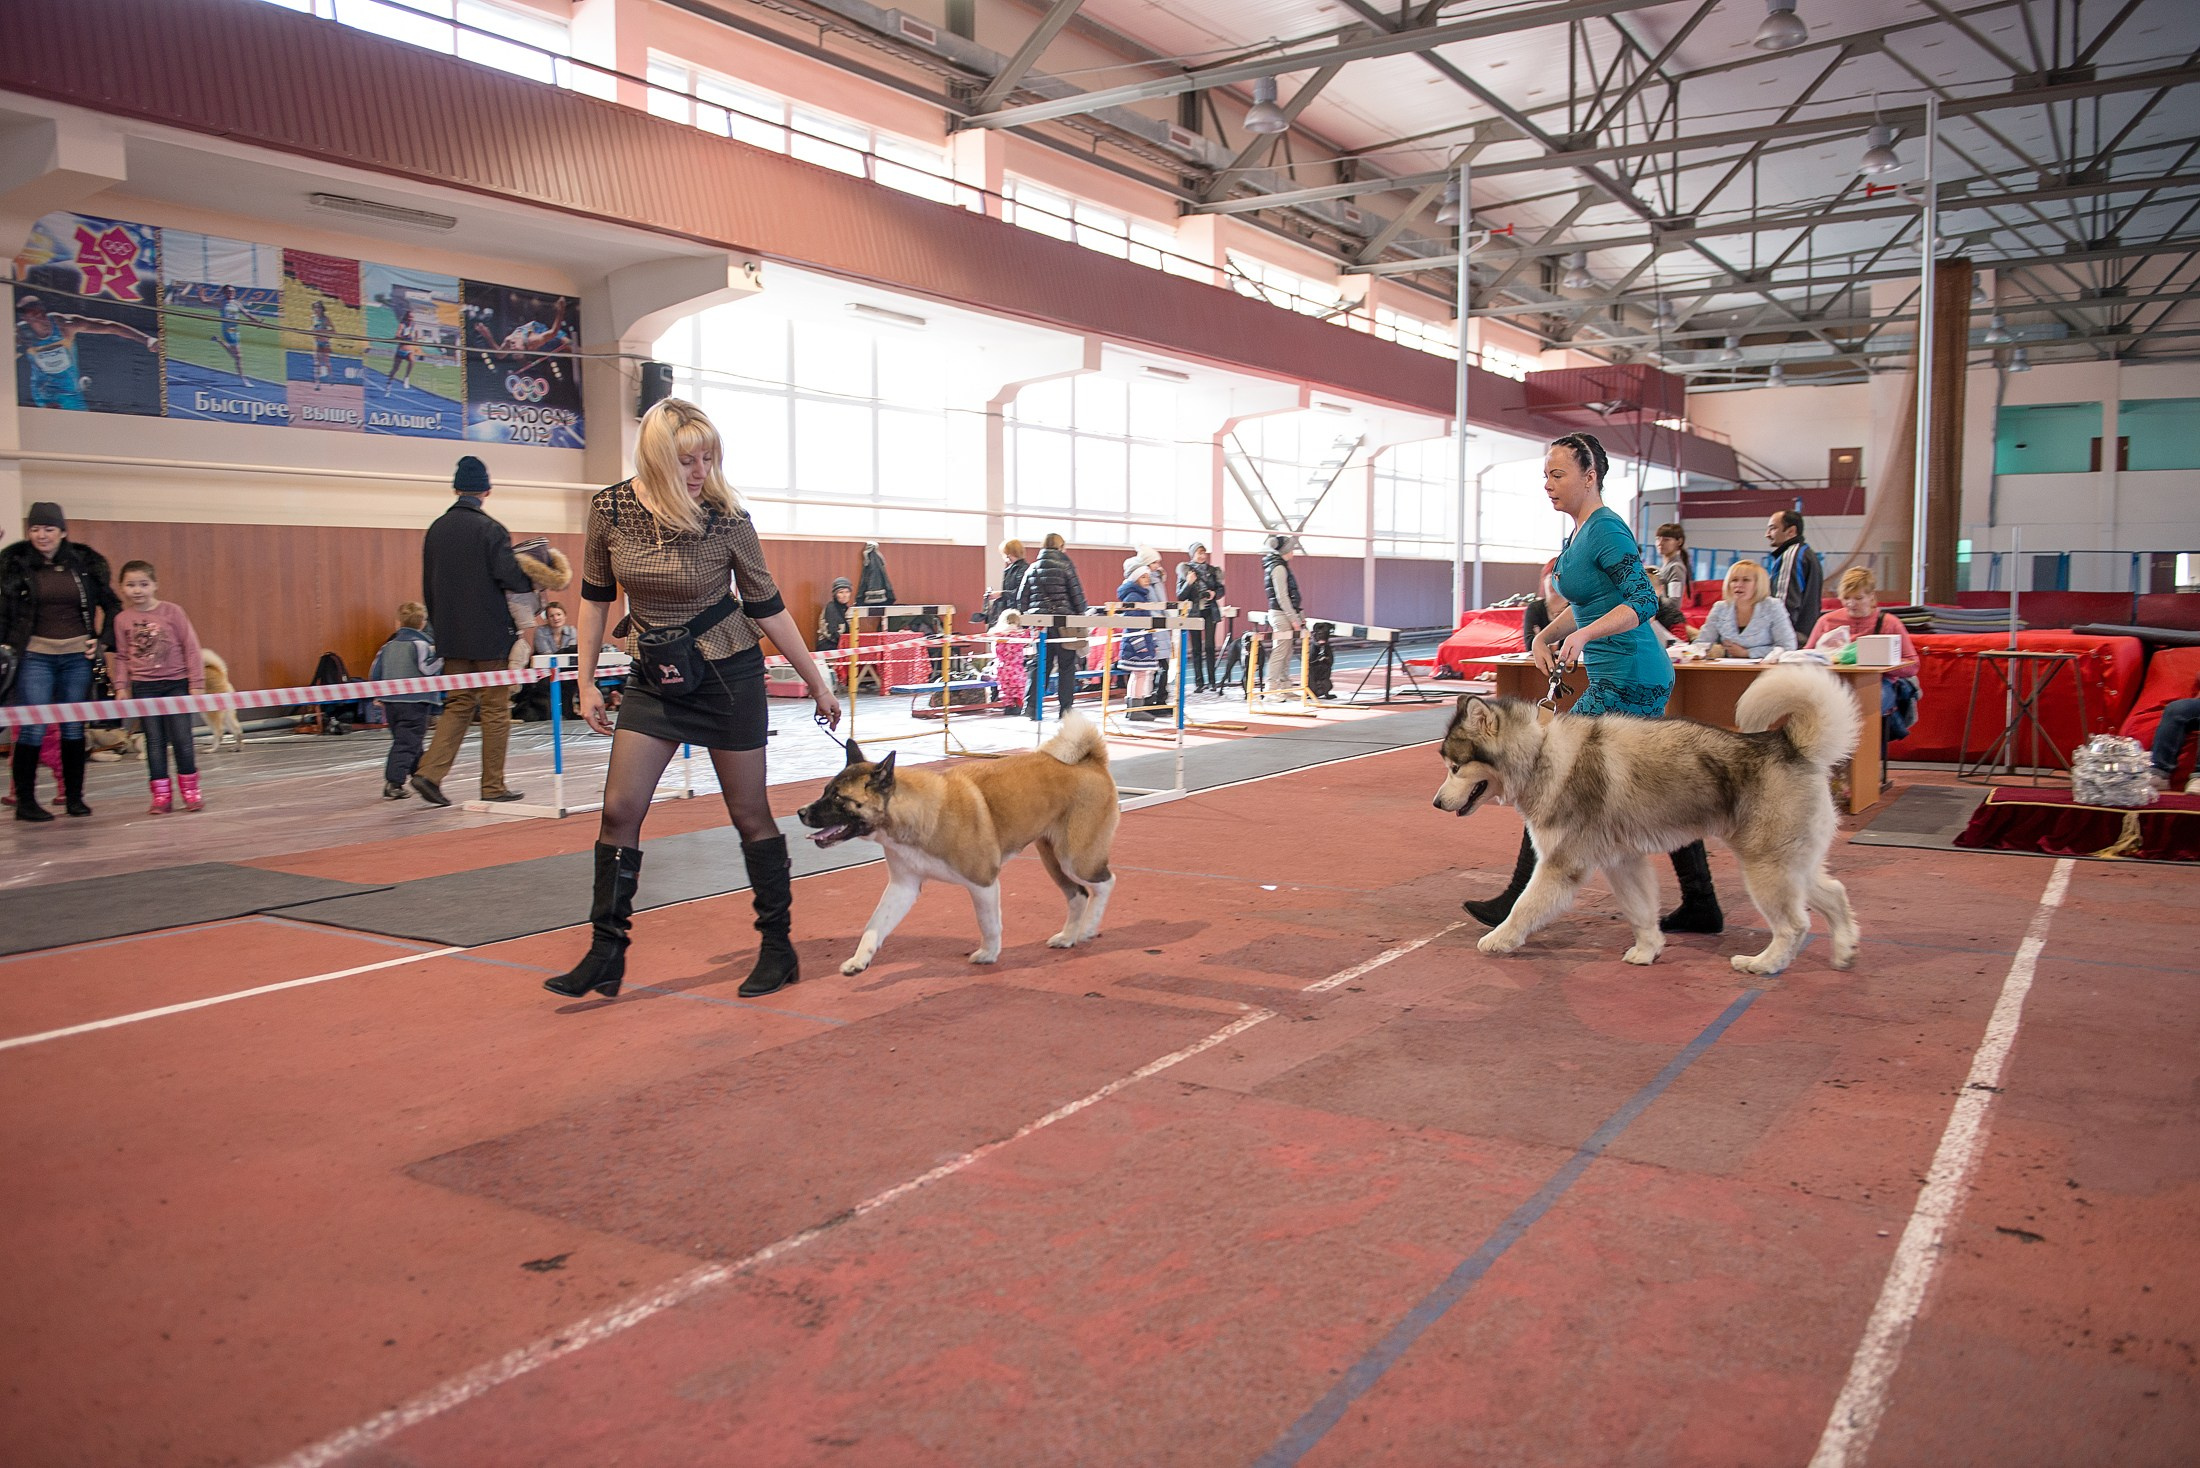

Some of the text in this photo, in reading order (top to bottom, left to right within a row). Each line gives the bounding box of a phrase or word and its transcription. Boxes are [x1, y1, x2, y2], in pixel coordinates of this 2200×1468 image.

[194, 391, 443, 431] Быстрее, выше, дальше!
[486, 402, 570, 426] LONDON
[509, 424, 549, 443] 2012
